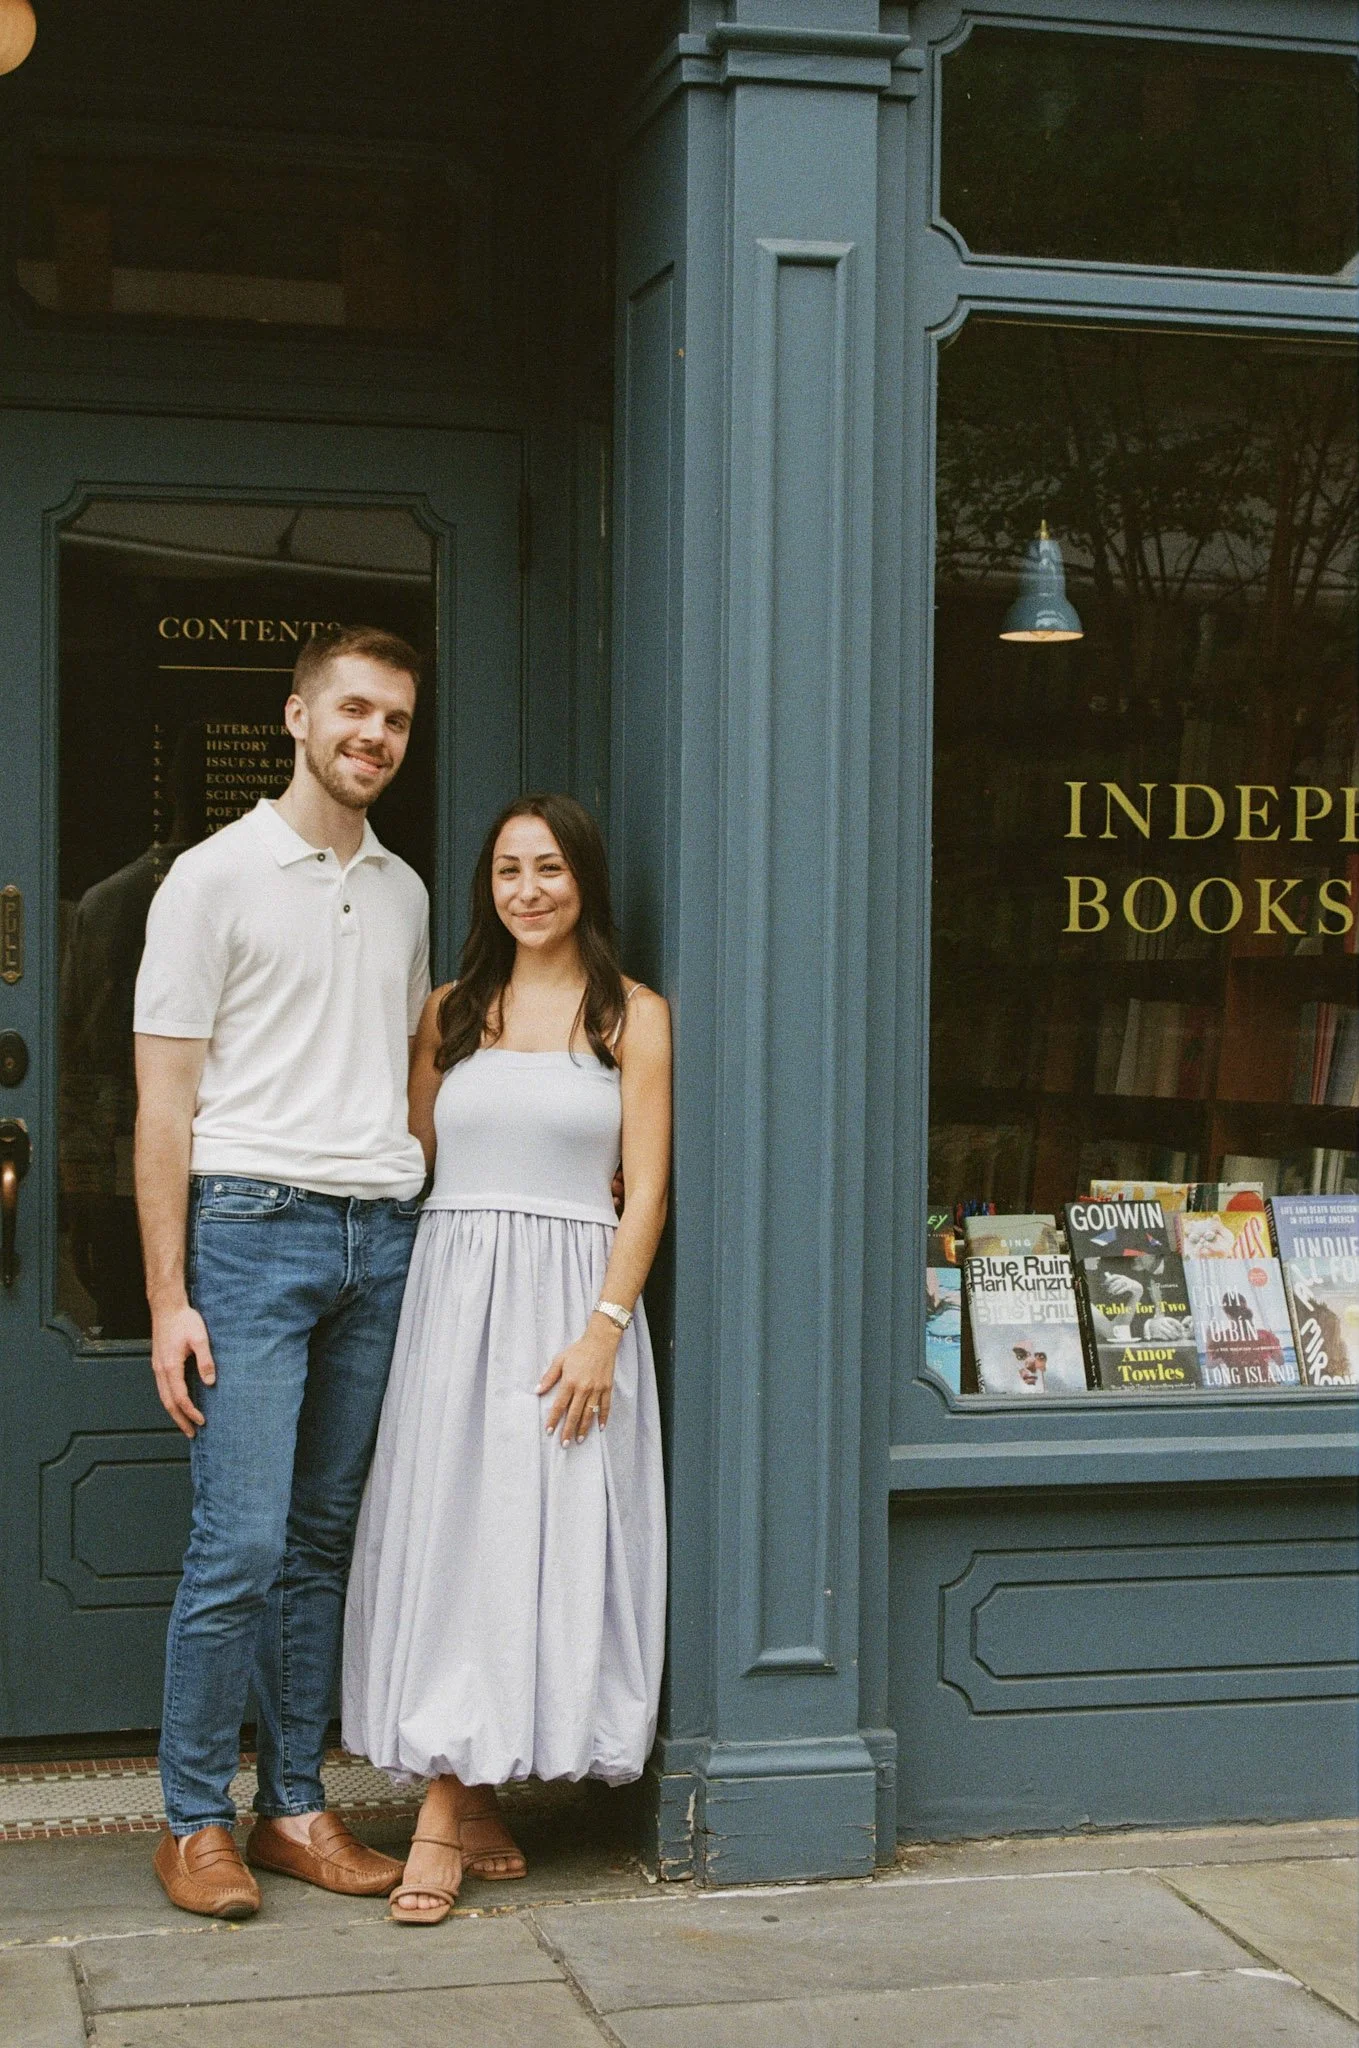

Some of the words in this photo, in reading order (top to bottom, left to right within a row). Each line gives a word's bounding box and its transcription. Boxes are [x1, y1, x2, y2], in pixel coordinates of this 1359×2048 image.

[205, 724, 290, 736] LITERATUR
[205, 740, 269, 752] HISTORY
[205, 756, 256, 768] ISSUES
[260, 758, 270, 768] &
[275, 758, 294, 769] PO
[205, 773, 292, 785] ECONOMICS
[205, 789, 268, 801] SCIENCE
[1062, 876, 1355, 935] BOOKS
[1070, 1202, 1165, 1231] GODWIN
[970, 1256, 1018, 1279] Blue
[1023, 1255, 1072, 1276] Ruin
[971, 1276, 1007, 1292] Hari
[1011, 1275, 1073, 1292] Kunzru
[1192, 1285, 1241, 1308] COLM
[1096, 1303, 1133, 1316] Table
[1136, 1302, 1155, 1314] for
[1160, 1301, 1186, 1313] Two
[1122, 1346, 1176, 1363] Amor
[1118, 1363, 1185, 1382] Towles
[1205, 1366, 1241, 1386] LONG
[1244, 1364, 1297, 1384] ISLAND
